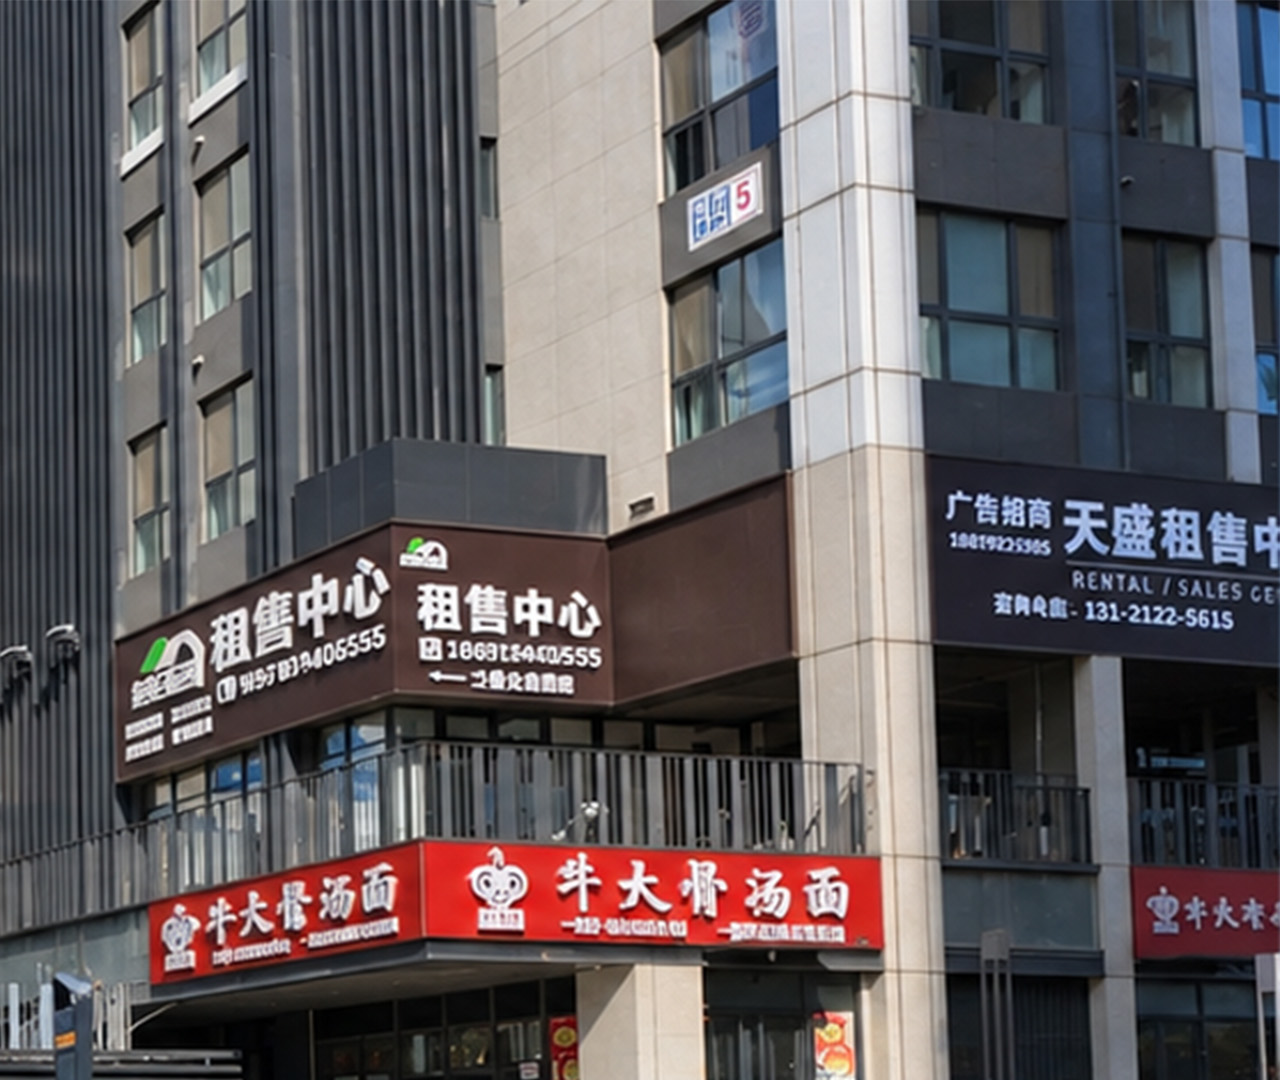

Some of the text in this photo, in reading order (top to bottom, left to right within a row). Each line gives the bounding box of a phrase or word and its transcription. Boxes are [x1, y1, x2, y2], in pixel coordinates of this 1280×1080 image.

[737, 181, 751, 210] 5
[1063, 499, 1280, 569] 天盛租售中
[209, 557, 390, 672] 租售中心
[417, 583, 602, 638] 租售中心
[1071, 570, 1154, 595] RENTAL
[1178, 579, 1242, 601] SALES
[1250, 585, 1280, 605] CE
